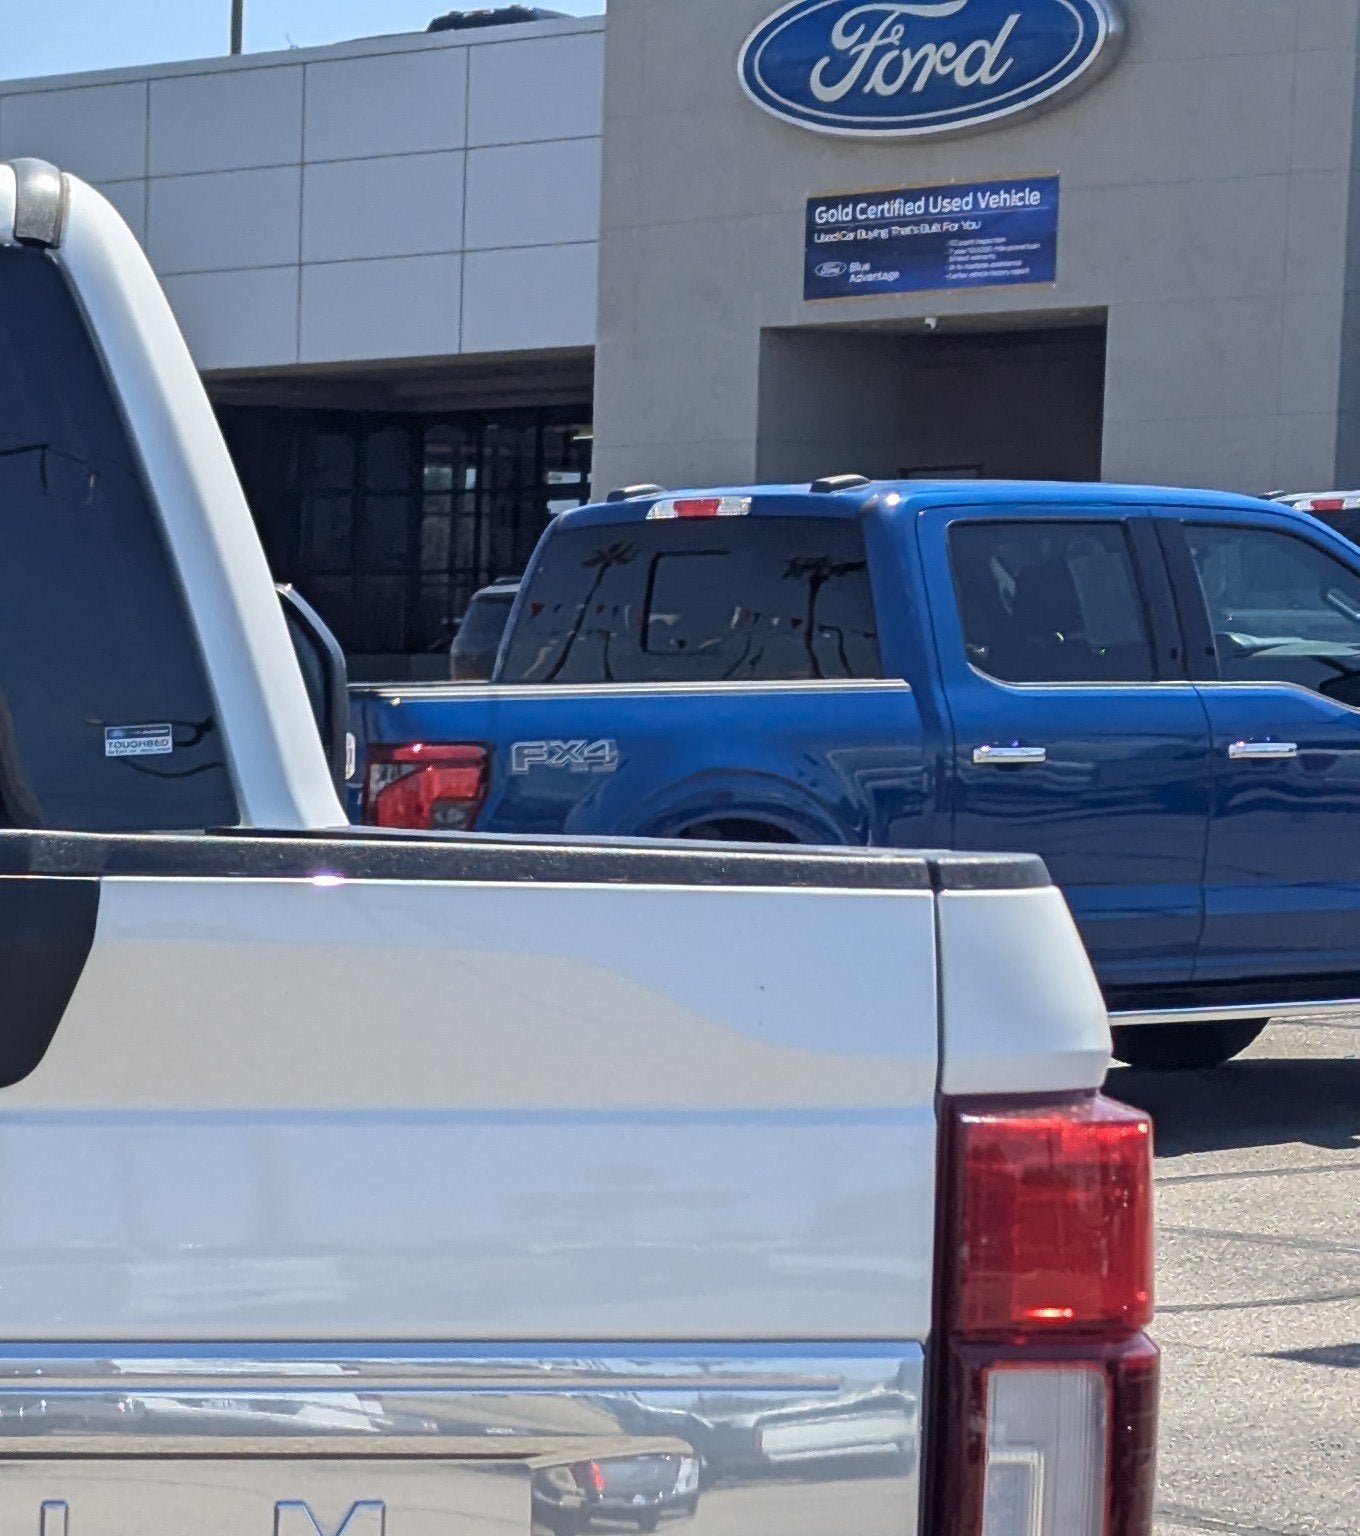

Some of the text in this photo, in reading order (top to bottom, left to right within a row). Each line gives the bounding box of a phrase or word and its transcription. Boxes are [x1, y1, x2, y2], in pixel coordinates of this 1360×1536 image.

[810, 0, 1022, 103] Ford
[814, 186, 1041, 224] Gold Certified Used Vehicle
[512, 740, 617, 773] FX4
